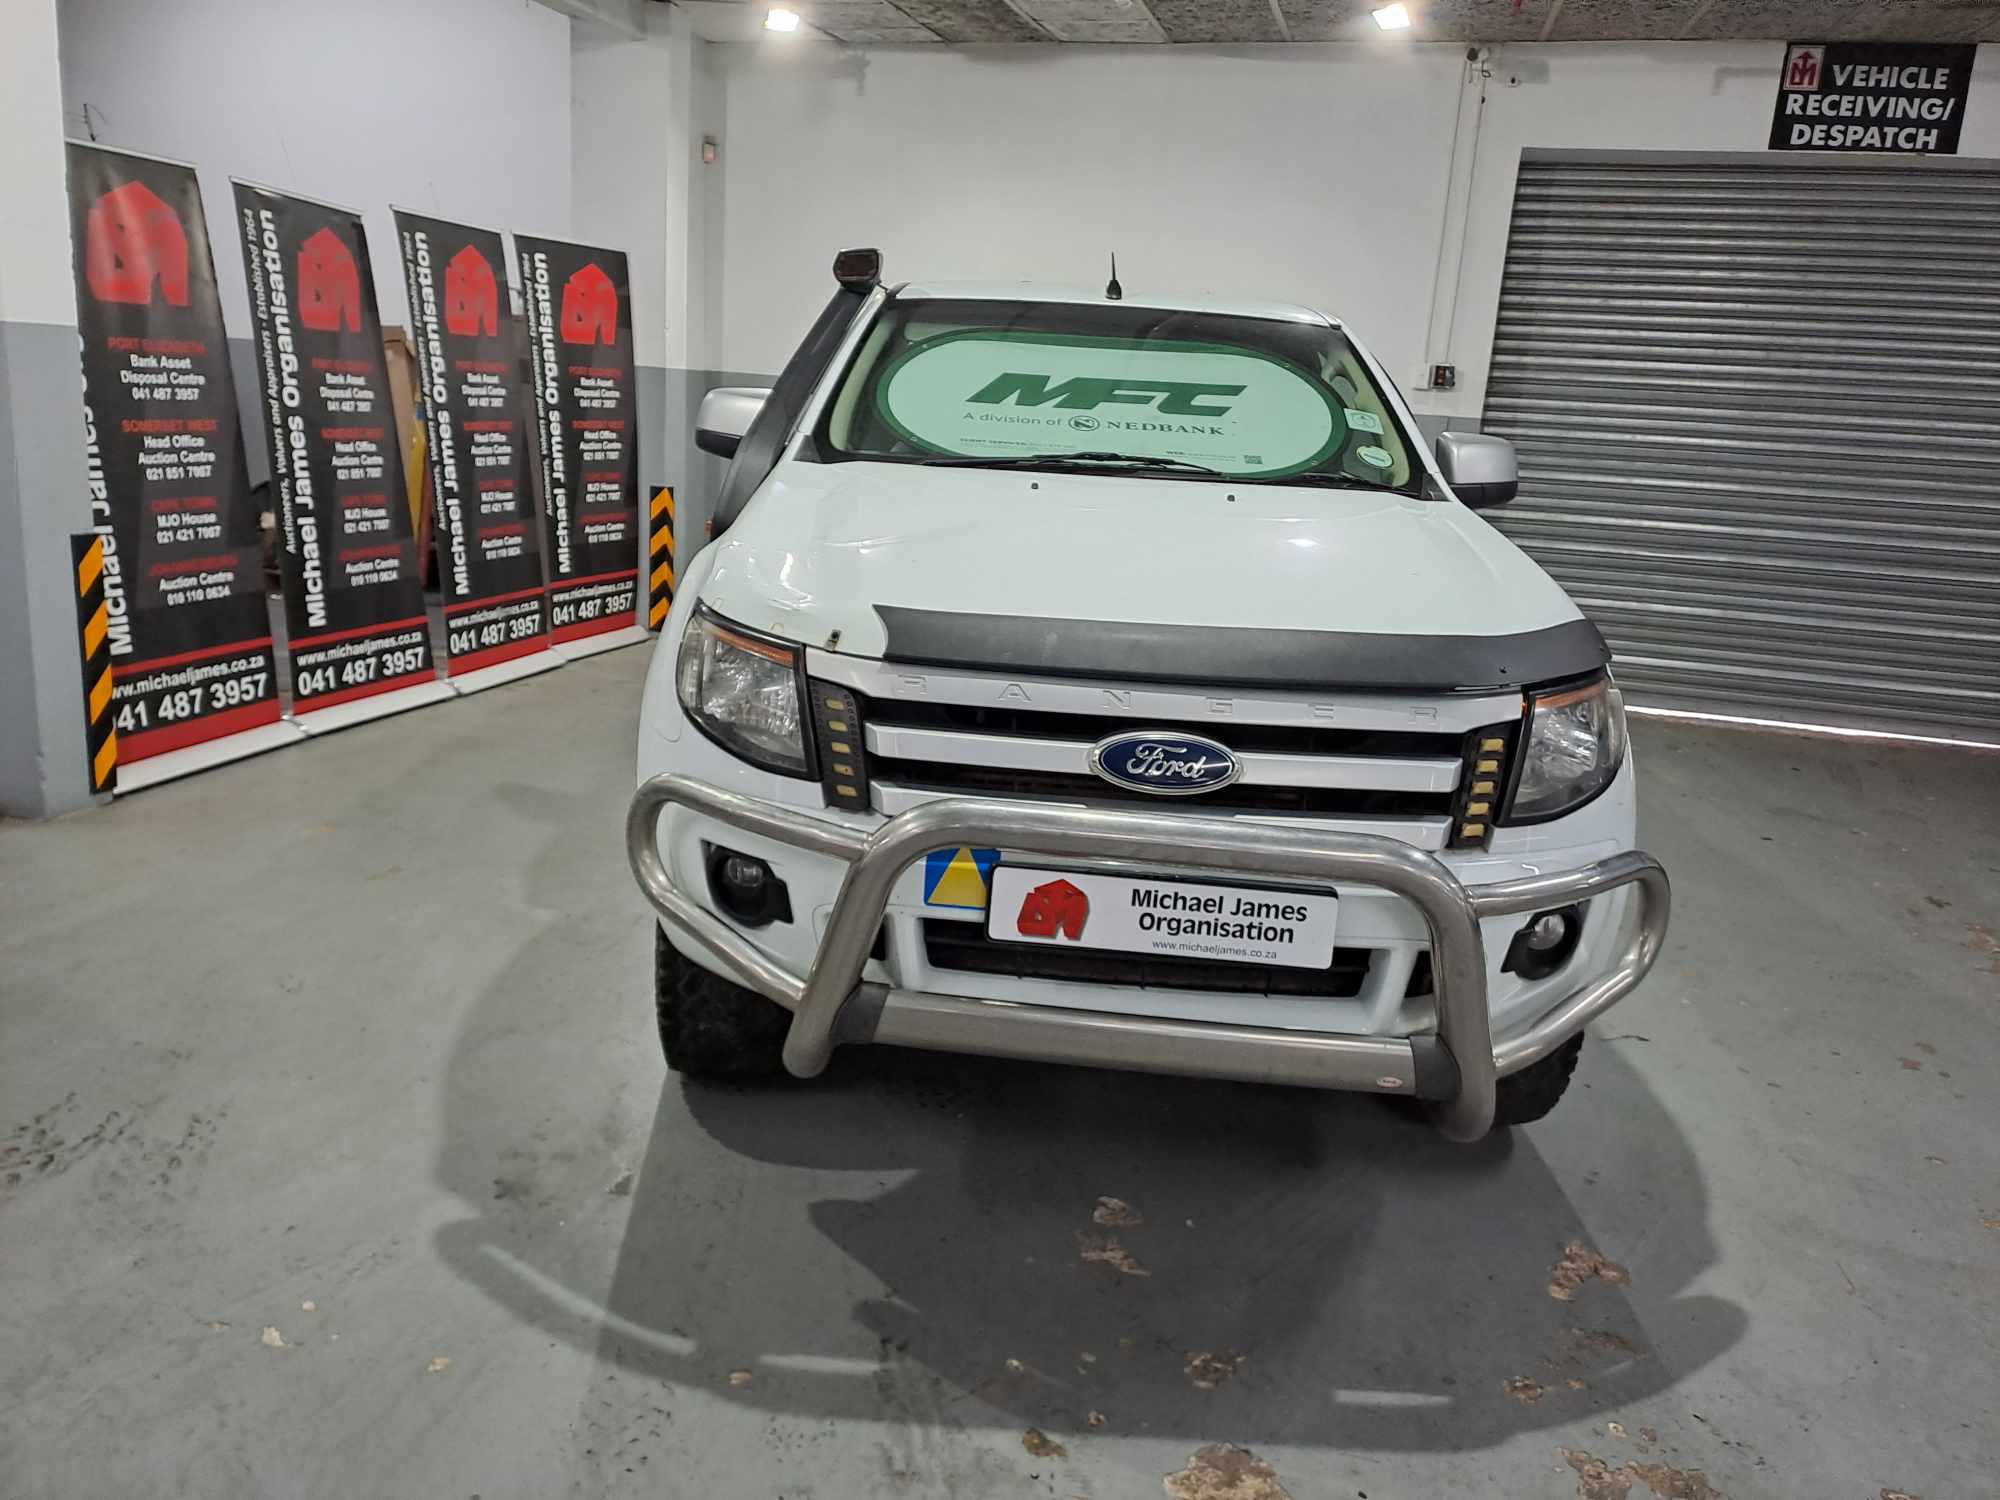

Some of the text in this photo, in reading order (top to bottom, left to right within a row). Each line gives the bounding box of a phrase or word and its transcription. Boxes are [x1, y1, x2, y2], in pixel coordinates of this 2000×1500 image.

[1832, 64, 1950, 90] VEHICLE
[1785, 94, 1955, 121] RECEIVING/
[1790, 124, 1938, 150] DESPATCH
[120, 370, 168, 385] Disposal
[130, 353, 192, 369] Bank Asset
[964, 372, 1248, 417] MFC
[268, 398, 281, 426] and
[963, 412, 1225, 436] A division of NEDBANK
[143, 434, 205, 448] Head Office
[437, 410, 459, 493] James
[548, 410, 565, 483] James
[138, 452, 179, 464] Auction
[288, 415, 314, 510] James
[446, 498, 470, 596] Michael
[553, 488, 572, 574] Michael
[159, 576, 199, 592] Auction
[297, 516, 327, 627] Michael
[553, 592, 633, 625] 041 487 3957
[297, 631, 422, 667] www.michaeljames.co.za
[450, 614, 540, 654] 041 487 3957
[298, 646, 425, 697] 041 487 3957
[113, 667, 268, 731] 41 487 3957
[897, 674, 1441, 727] RANGER
[1126, 743, 1207, 778] Ford
[1131, 889, 1308, 922] Michael James
[1139, 912, 1294, 943] Organisation
[1152, 940, 1277, 960] www.michaeljames.co.za
